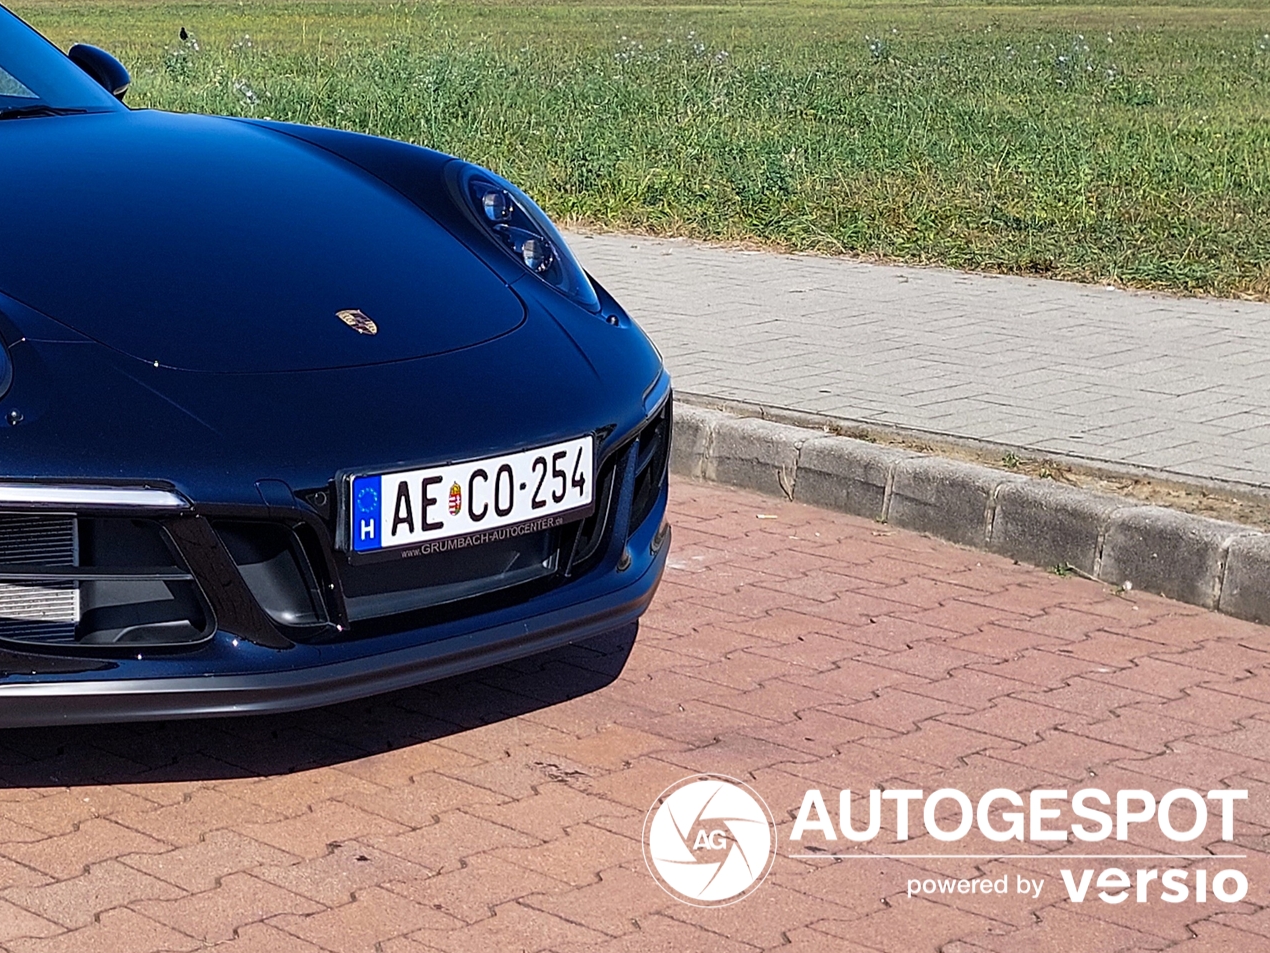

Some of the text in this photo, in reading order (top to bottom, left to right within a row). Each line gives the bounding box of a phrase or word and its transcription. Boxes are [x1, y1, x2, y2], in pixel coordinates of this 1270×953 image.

[391, 475, 444, 537] AE
[361, 518, 374, 540] H
[401, 517, 564, 559] www.GRUMBACH-AUTOCENTER.de
